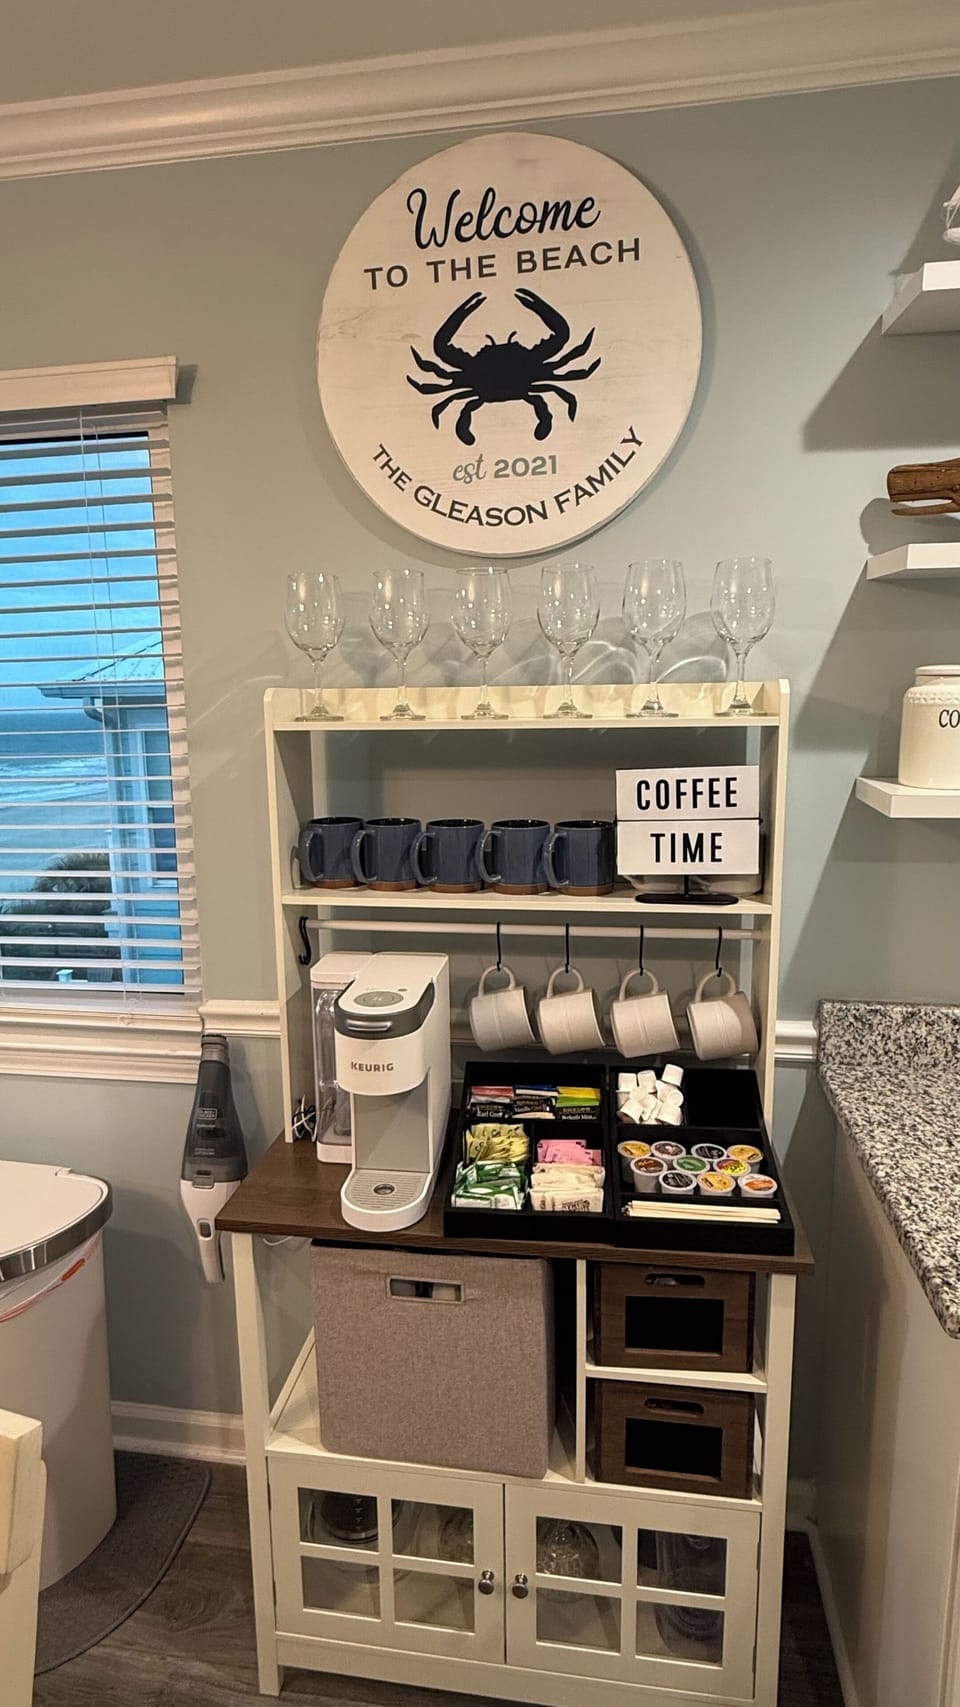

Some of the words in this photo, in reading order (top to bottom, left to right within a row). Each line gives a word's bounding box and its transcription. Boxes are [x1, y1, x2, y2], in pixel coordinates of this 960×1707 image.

[407, 187, 601, 249] Welcome
[364, 266, 407, 289] TO
[426, 255, 496, 283] THE
[516, 238, 640, 274] BEACH
[373, 443, 412, 491] THE
[415, 486, 547, 526] GLEASON
[554, 426, 643, 513] FAMILY
[452, 453, 487, 484] est
[494, 455, 557, 479] 2021
[637, 777, 738, 810] COFFEE
[650, 832, 723, 863] TIME
[350, 1061, 395, 1072] KEURIG
